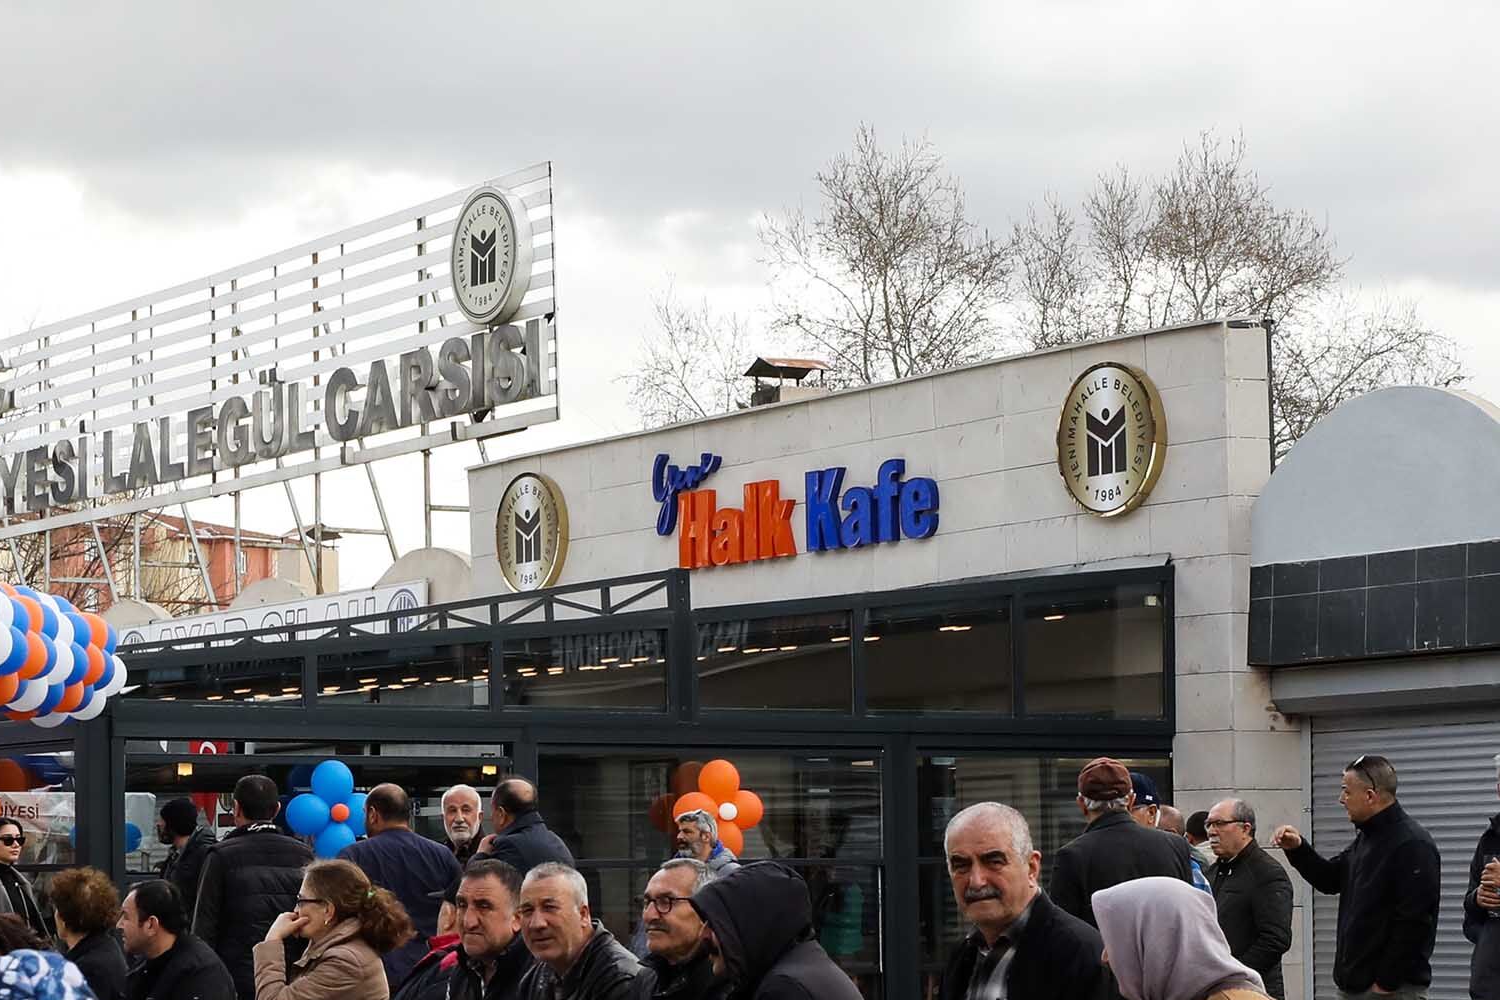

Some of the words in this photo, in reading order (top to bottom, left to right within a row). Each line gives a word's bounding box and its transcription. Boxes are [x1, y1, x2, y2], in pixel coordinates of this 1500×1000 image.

[474, 293, 492, 307] 1984
[103, 367, 315, 495] LALEGÜL
[677, 479, 798, 569] Halk
[804, 458, 940, 553] Kafe
[1094, 485, 1122, 502] 1984
